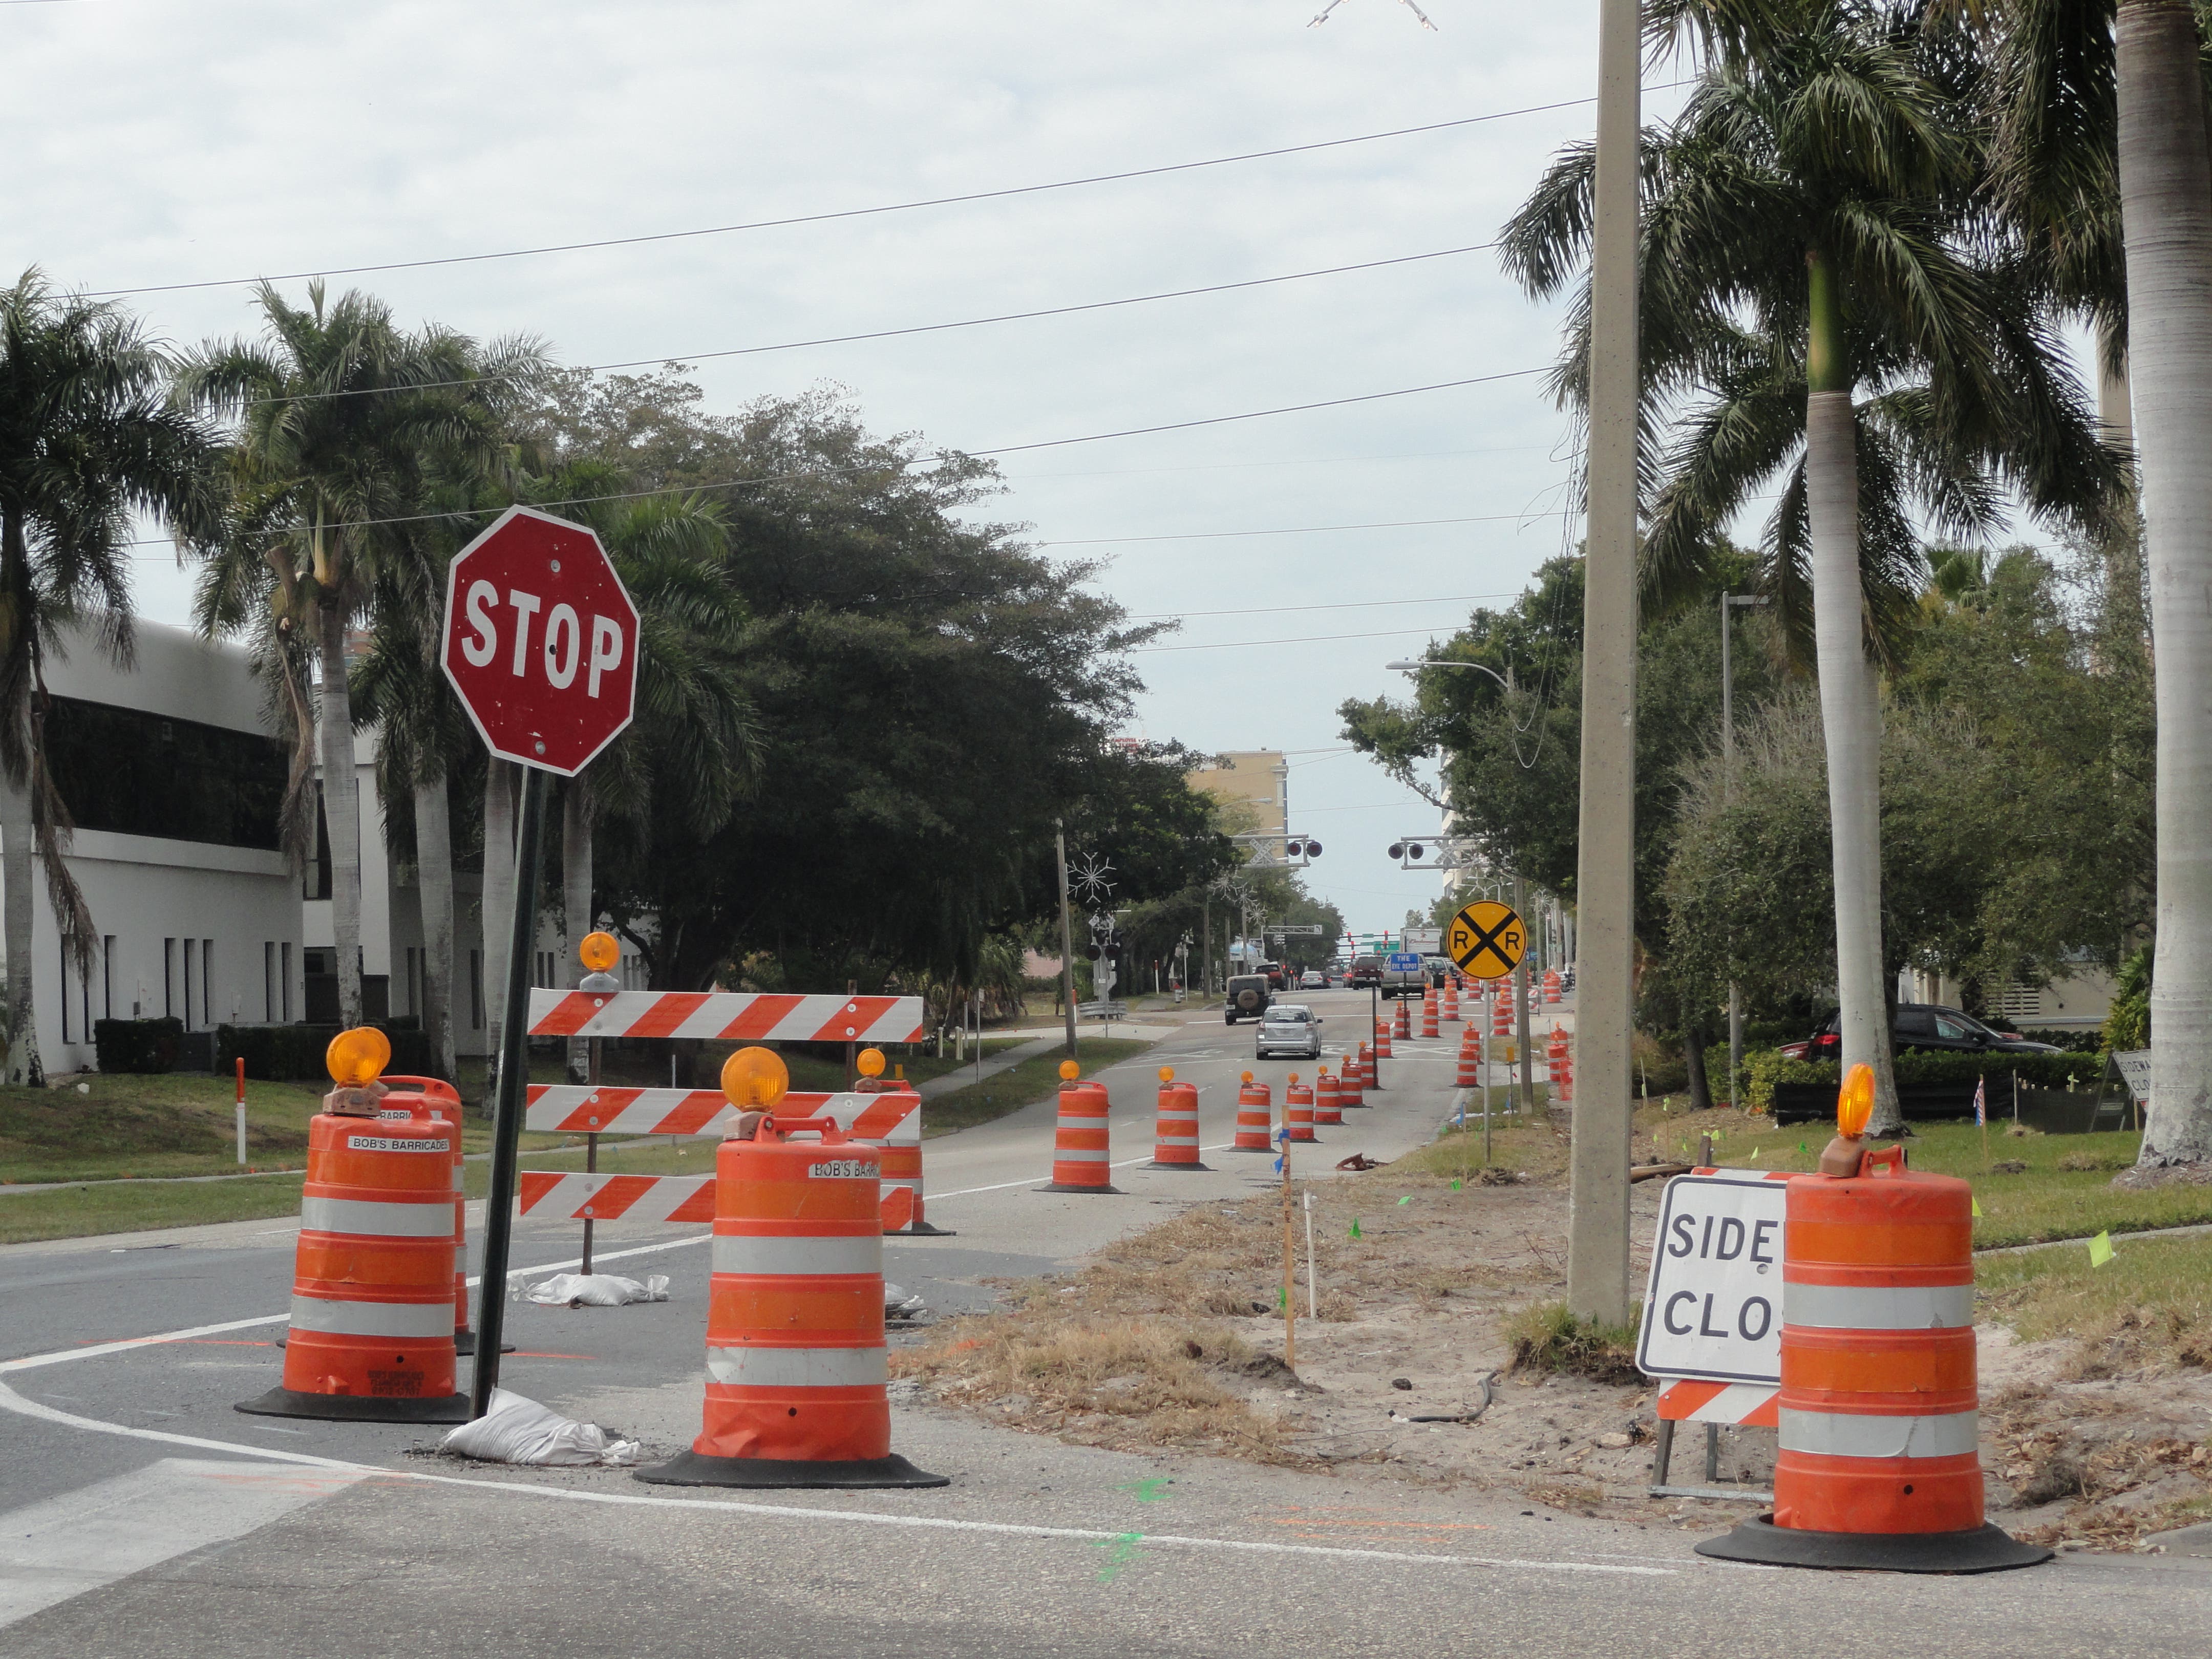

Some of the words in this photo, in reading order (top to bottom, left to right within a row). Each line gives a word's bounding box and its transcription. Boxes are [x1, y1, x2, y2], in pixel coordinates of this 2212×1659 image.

[461, 579, 623, 698] STOP
[1454, 930, 1469, 949] R
[1505, 931, 1520, 950] R
[2120, 1060, 2151, 1072] SIDEWA
[380, 1112, 411, 1120] BARRI
[353, 1138, 387, 1149] BOB'S
[392, 1140, 448, 1151] BARRICADES
[815, 1163, 850, 1177] BOB'S
[1667, 1214, 1786, 1264] SIDE
[1664, 1290, 1784, 1343] CLO
